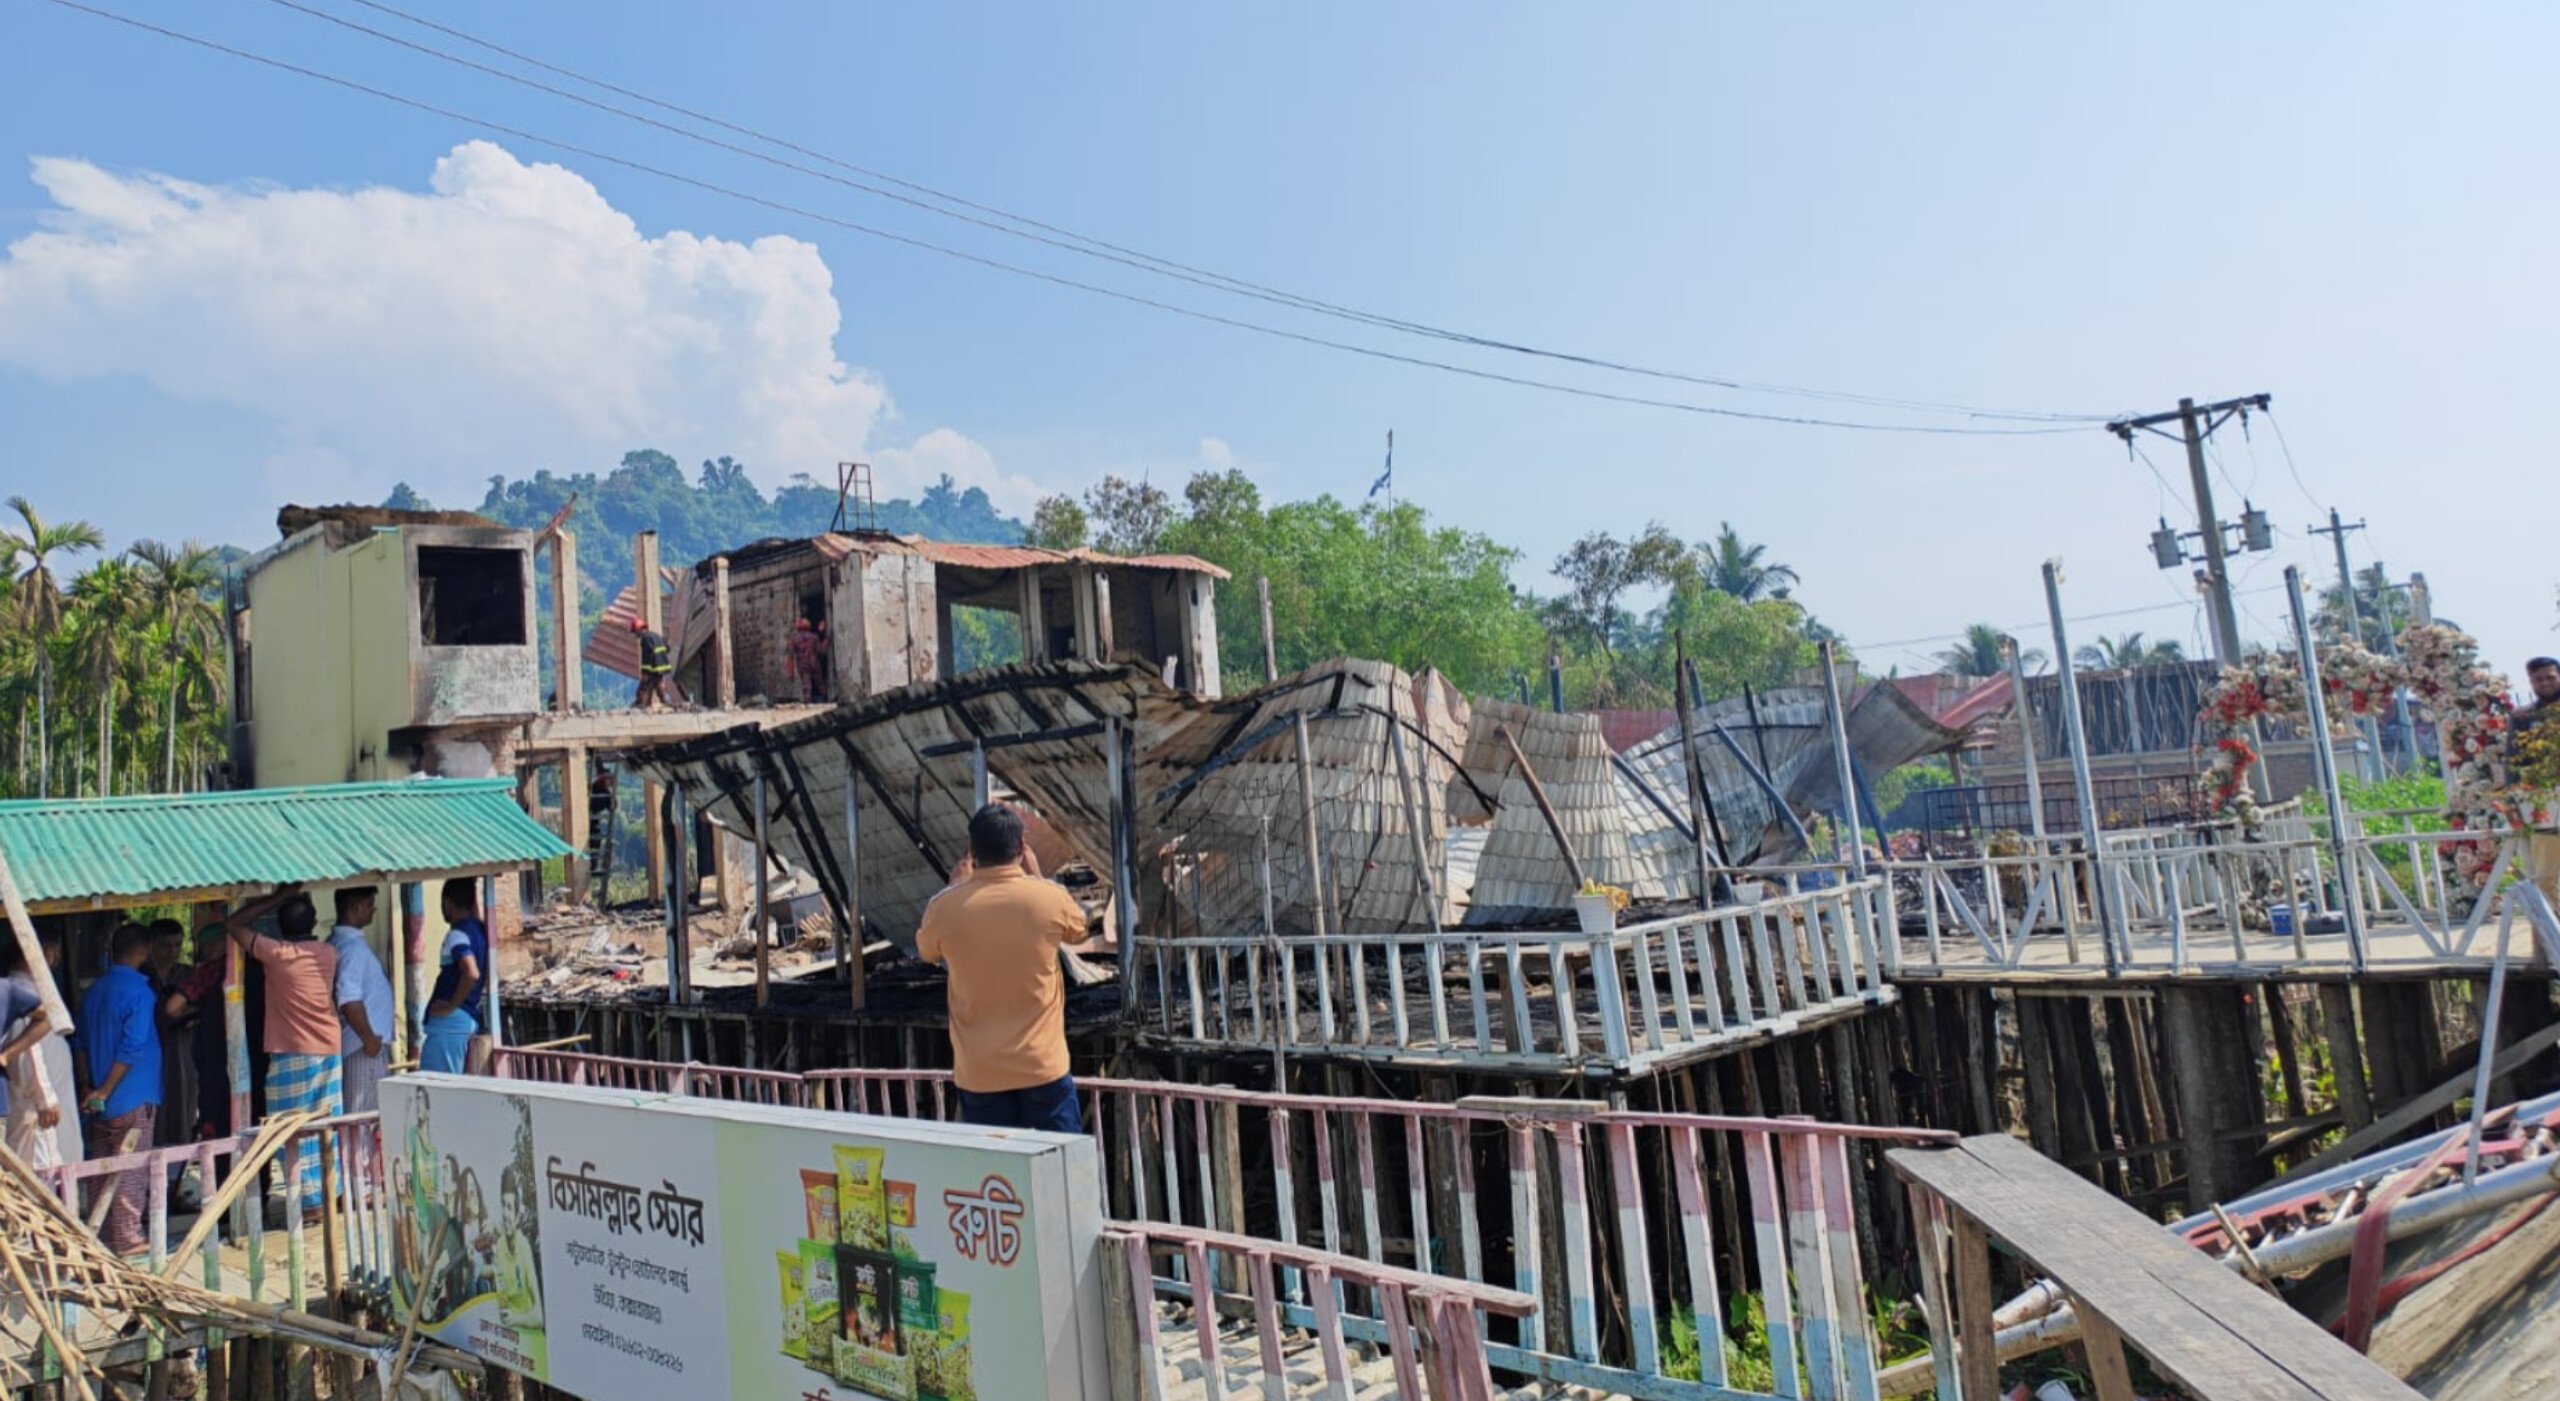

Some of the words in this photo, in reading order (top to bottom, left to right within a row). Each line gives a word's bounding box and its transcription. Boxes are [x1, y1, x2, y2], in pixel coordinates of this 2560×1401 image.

[546, 1155, 643, 1236] বিসমিল্লাহ
[648, 1178, 705, 1248] স্টোর
[944, 1174, 1024, 1268] রুচি
